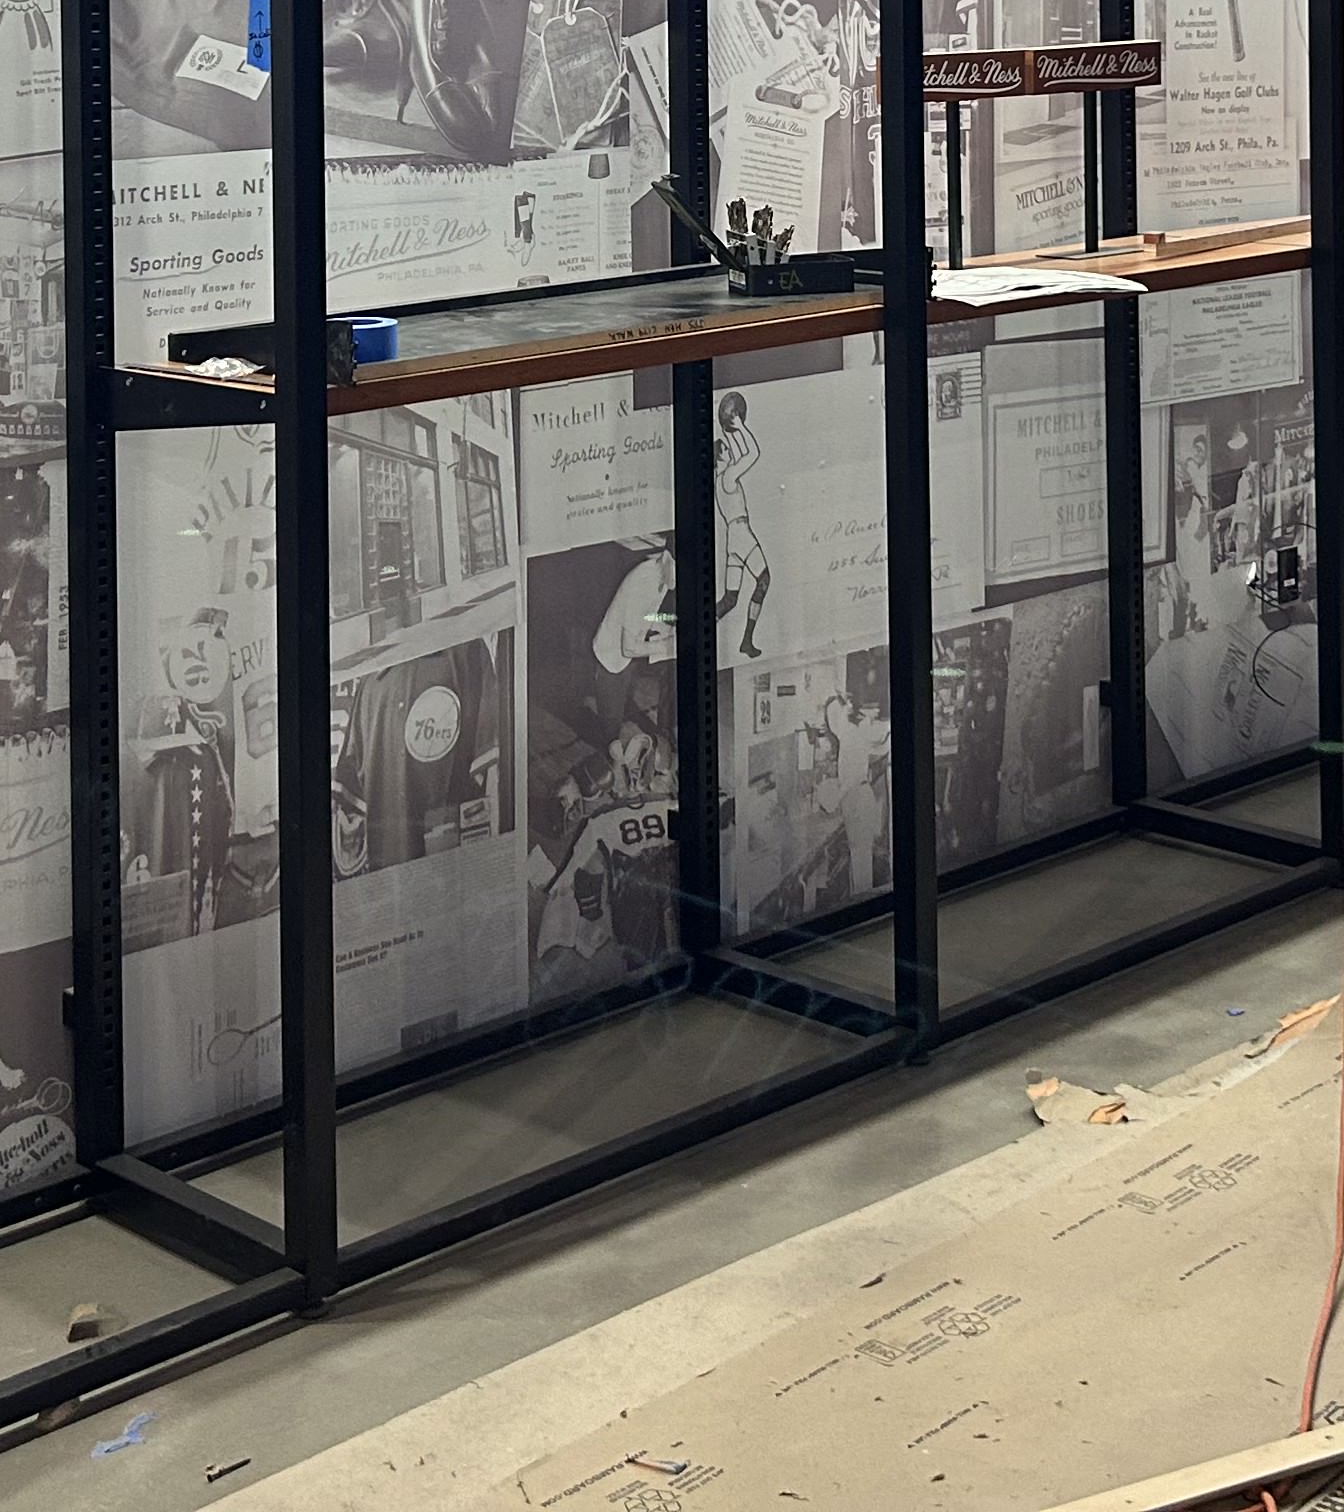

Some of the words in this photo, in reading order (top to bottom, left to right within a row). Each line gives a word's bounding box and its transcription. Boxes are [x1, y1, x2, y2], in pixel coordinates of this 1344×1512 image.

[969, 67, 982, 83] &
[983, 58, 1023, 85] Ness
[1036, 52, 1106, 79] Mitchell
[1106, 57, 1119, 74] &
[1119, 49, 1158, 74] Ness
[1169, 88, 1200, 102] Walter
[1203, 87, 1232, 103] Hagen
[1234, 86, 1253, 98] Golf
[1255, 85, 1280, 98] Clubs
[1169, 141, 1191, 154] 1209
[1194, 140, 1216, 153] Arch
[216, 180, 229, 197] &
[137, 212, 164, 225] Arch
[191, 208, 253, 222] Philadelphia
[257, 206, 264, 217] 7
[129, 251, 204, 276] Sporting
[211, 244, 265, 265] Goods
[142, 285, 197, 300] Nationally
[201, 282, 236, 294] Known
[240, 279, 257, 290] for
[146, 304, 186, 317] Service
[190, 302, 209, 313] and
[214, 299, 253, 311] Quality
[532, 401, 606, 433] Mitchell
[617, 399, 631, 418] &
[550, 443, 617, 473] Sporting
[623, 431, 665, 456] Goods
[618, 812, 666, 847] 89
